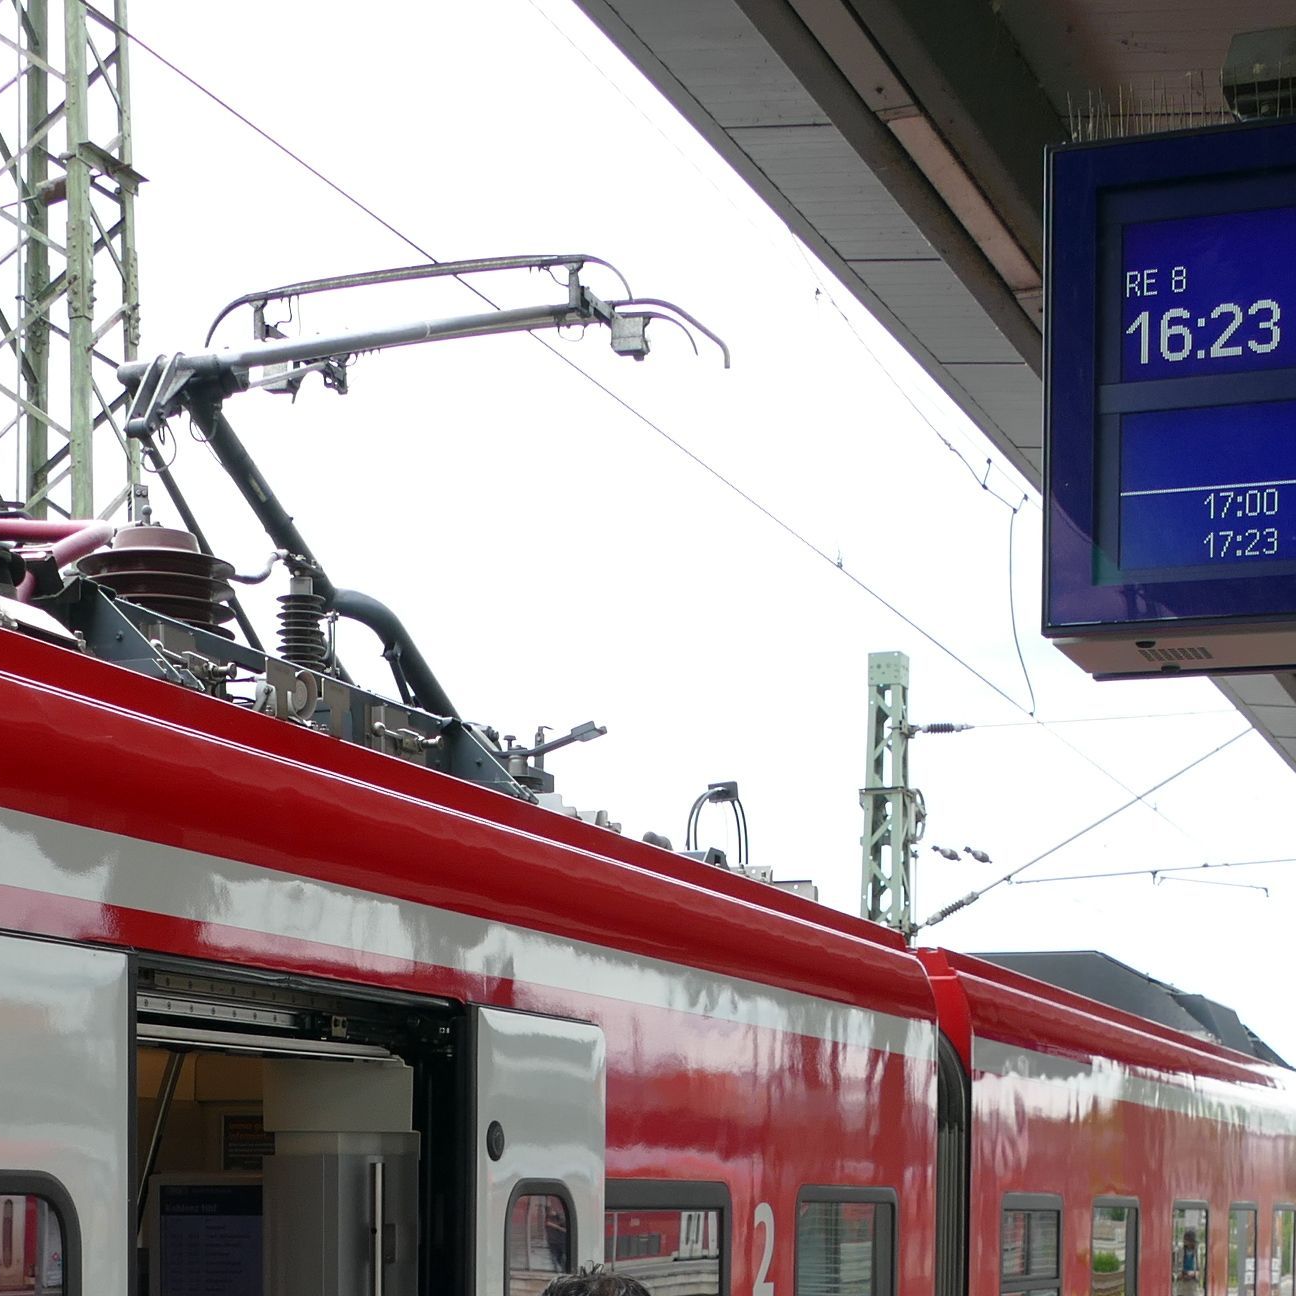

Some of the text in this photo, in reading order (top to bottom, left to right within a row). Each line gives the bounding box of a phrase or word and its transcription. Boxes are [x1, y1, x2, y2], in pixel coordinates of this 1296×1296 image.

[1126, 266, 1186, 298] RE 8
[1126, 299, 1281, 364] 16:23
[1203, 489, 1279, 520] 17:00
[1203, 527, 1278, 558] 17:23
